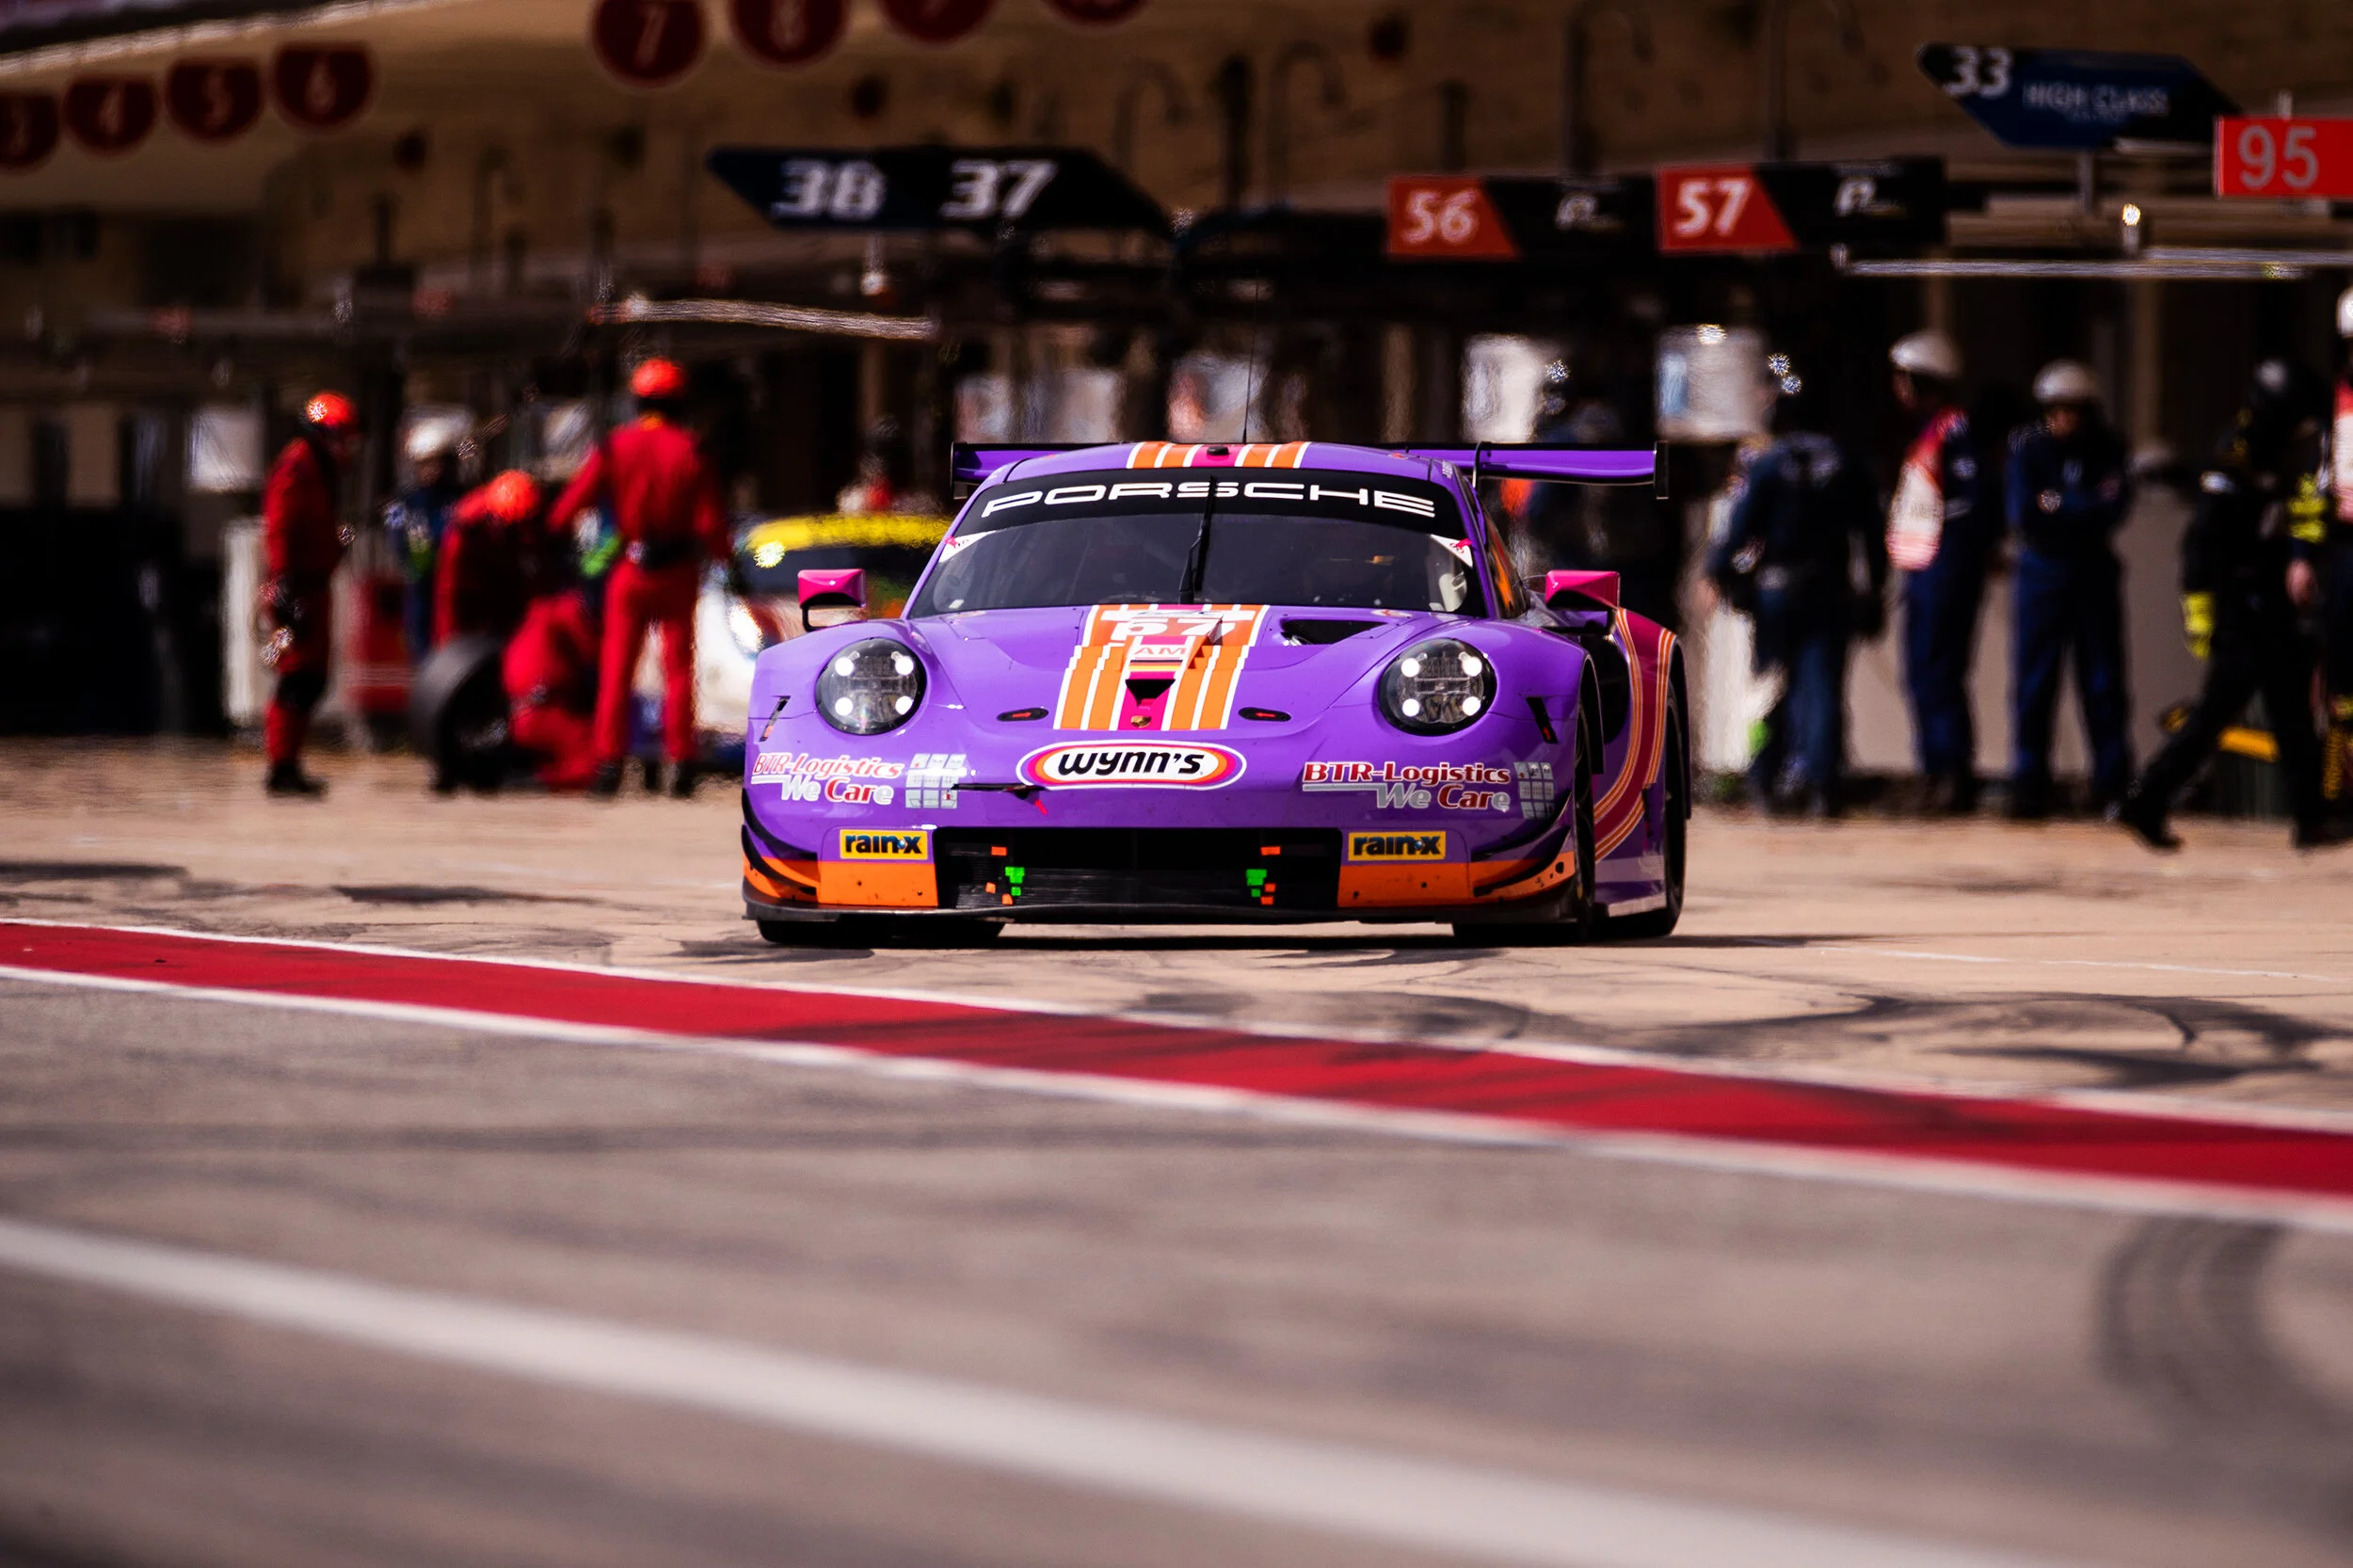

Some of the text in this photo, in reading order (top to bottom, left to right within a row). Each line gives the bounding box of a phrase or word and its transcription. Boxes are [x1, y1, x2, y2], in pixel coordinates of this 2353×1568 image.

[1943, 44, 2016, 101] 33
[2235, 122, 2322, 193] 95
[769, 156, 1064, 221] 38 37
[1399, 187, 1481, 247] 56
[1672, 176, 1754, 239] 57
[982, 479, 1436, 519] PORSCHE
[1133, 646, 1187, 657] AM
[752, 752, 906, 779] BTR-Logistics
[1058, 750, 1206, 776] wynn's
[1302, 760, 1512, 785] BTR-Logistics
[779, 775, 894, 805] We Care
[1375, 782, 1512, 811] We Care
